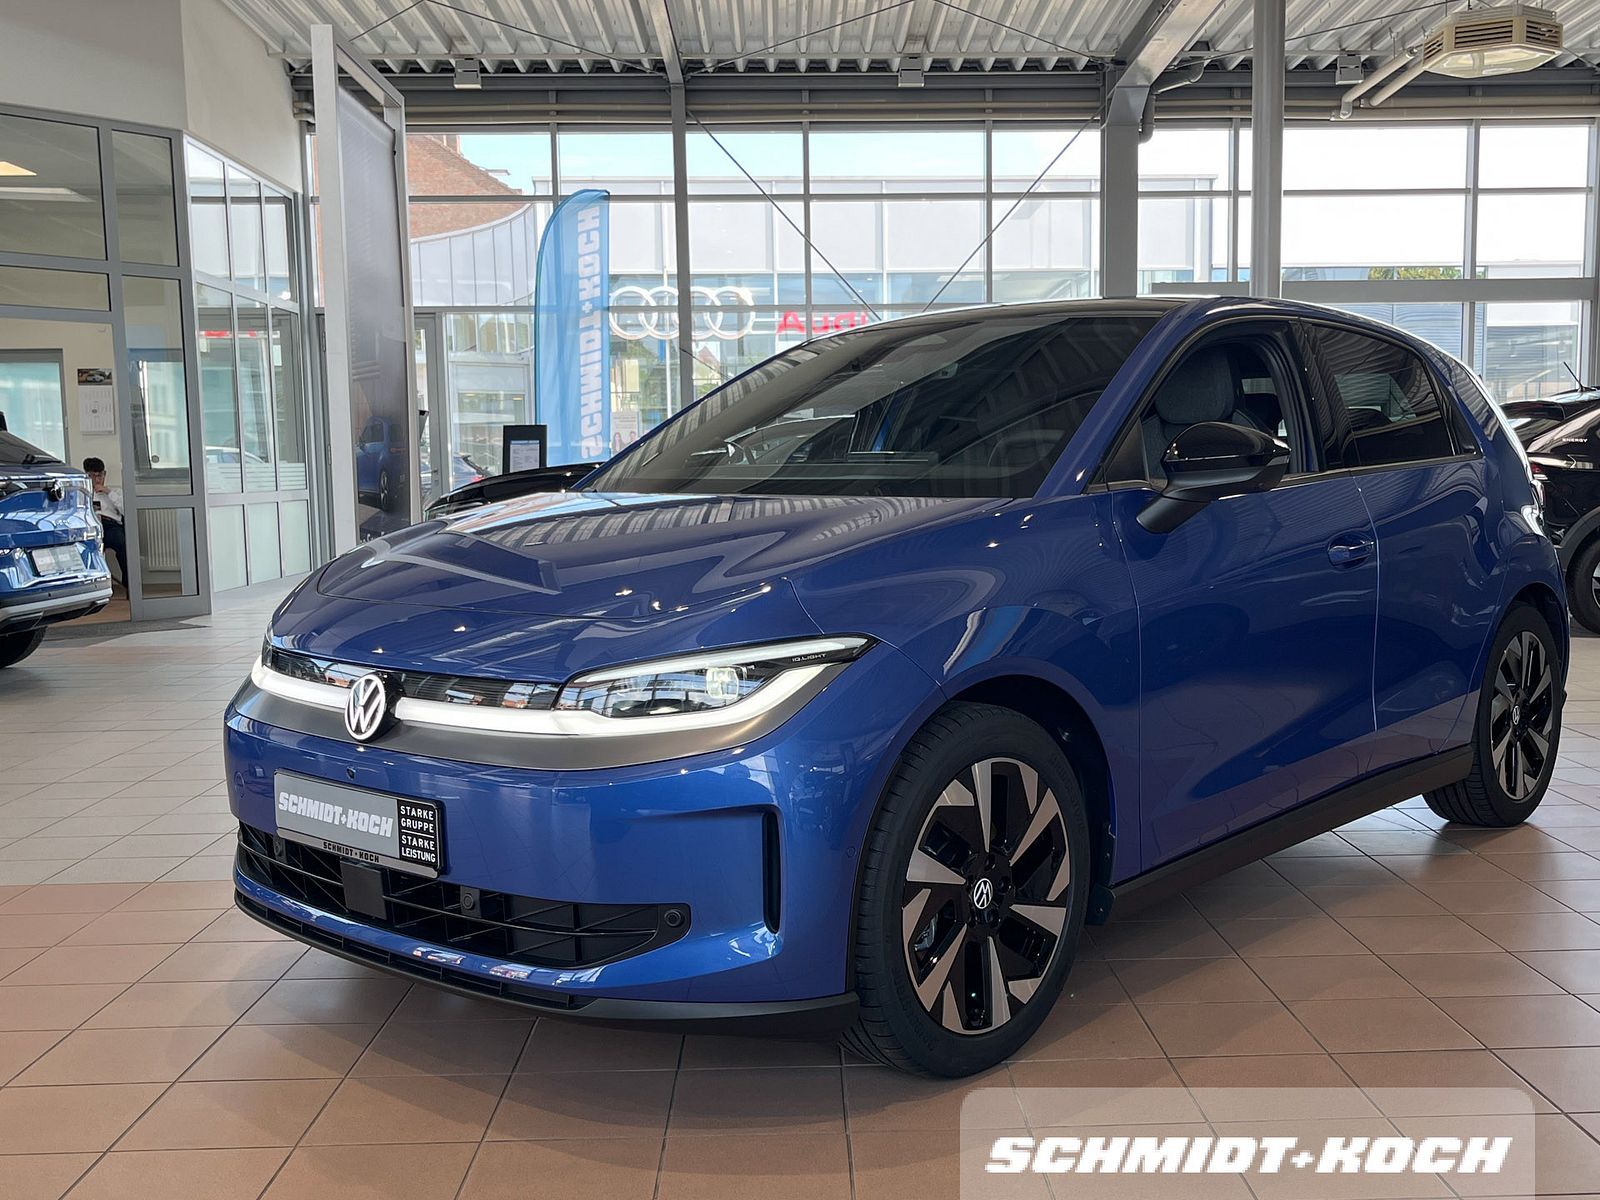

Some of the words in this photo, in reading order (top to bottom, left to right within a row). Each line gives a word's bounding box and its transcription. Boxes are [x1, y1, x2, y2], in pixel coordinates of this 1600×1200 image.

[278, 792, 394, 838] SCHMIDT+KOCH
[400, 805, 434, 821] STARKE
[401, 819, 435, 833] GRUPPE
[401, 835, 435, 851] STARKE
[401, 847, 436, 863] LEISTUNG
